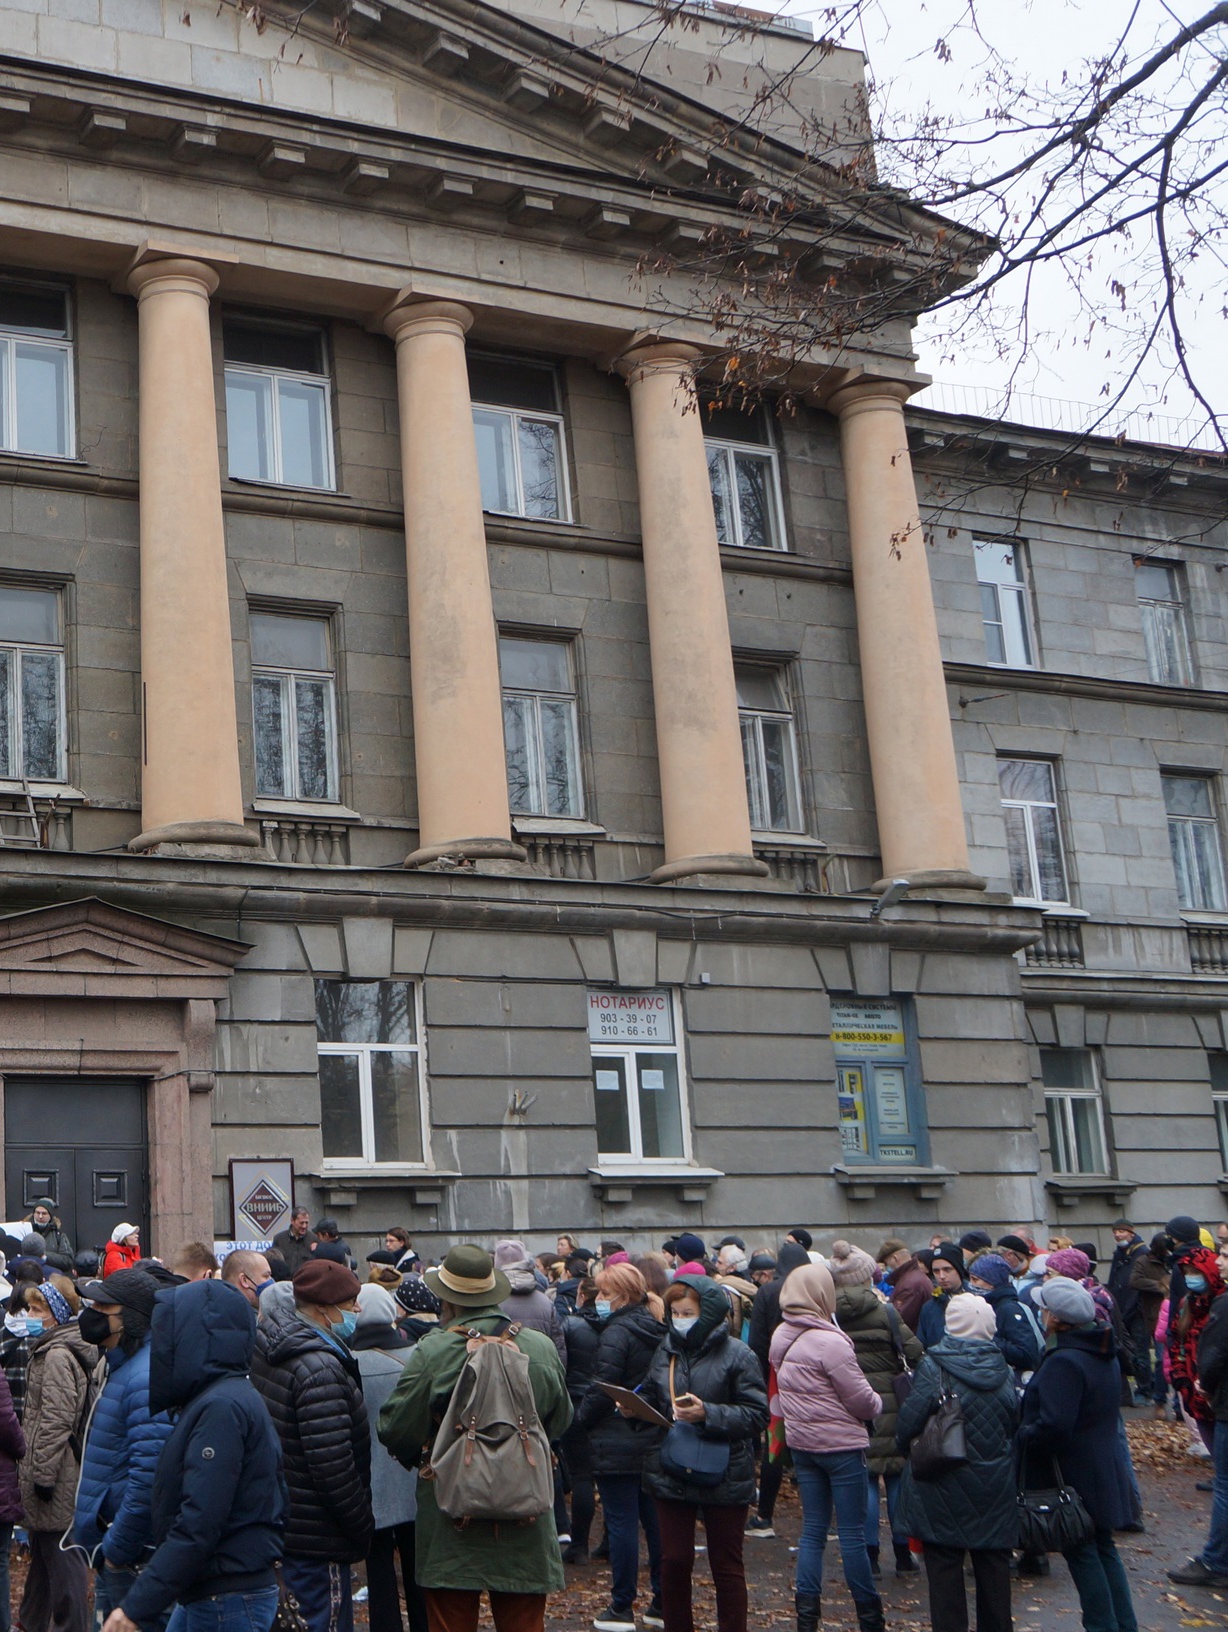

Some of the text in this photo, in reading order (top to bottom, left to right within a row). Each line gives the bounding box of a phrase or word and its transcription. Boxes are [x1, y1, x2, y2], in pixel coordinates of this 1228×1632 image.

[590, 996, 665, 1010] НОТАРИУС
[600, 1013, 618, 1024] 903
[626, 1014, 638, 1024] 39
[646, 1014, 657, 1024] 07
[601, 1026, 618, 1036] 910
[627, 1026, 639, 1036] 66
[647, 1026, 658, 1036] 61
[835, 1032, 892, 1041] 8-800-550-3-567
[246, 1202, 283, 1213] ВНИИБ
[227, 1241, 272, 1250] ЭТОТ ДО
